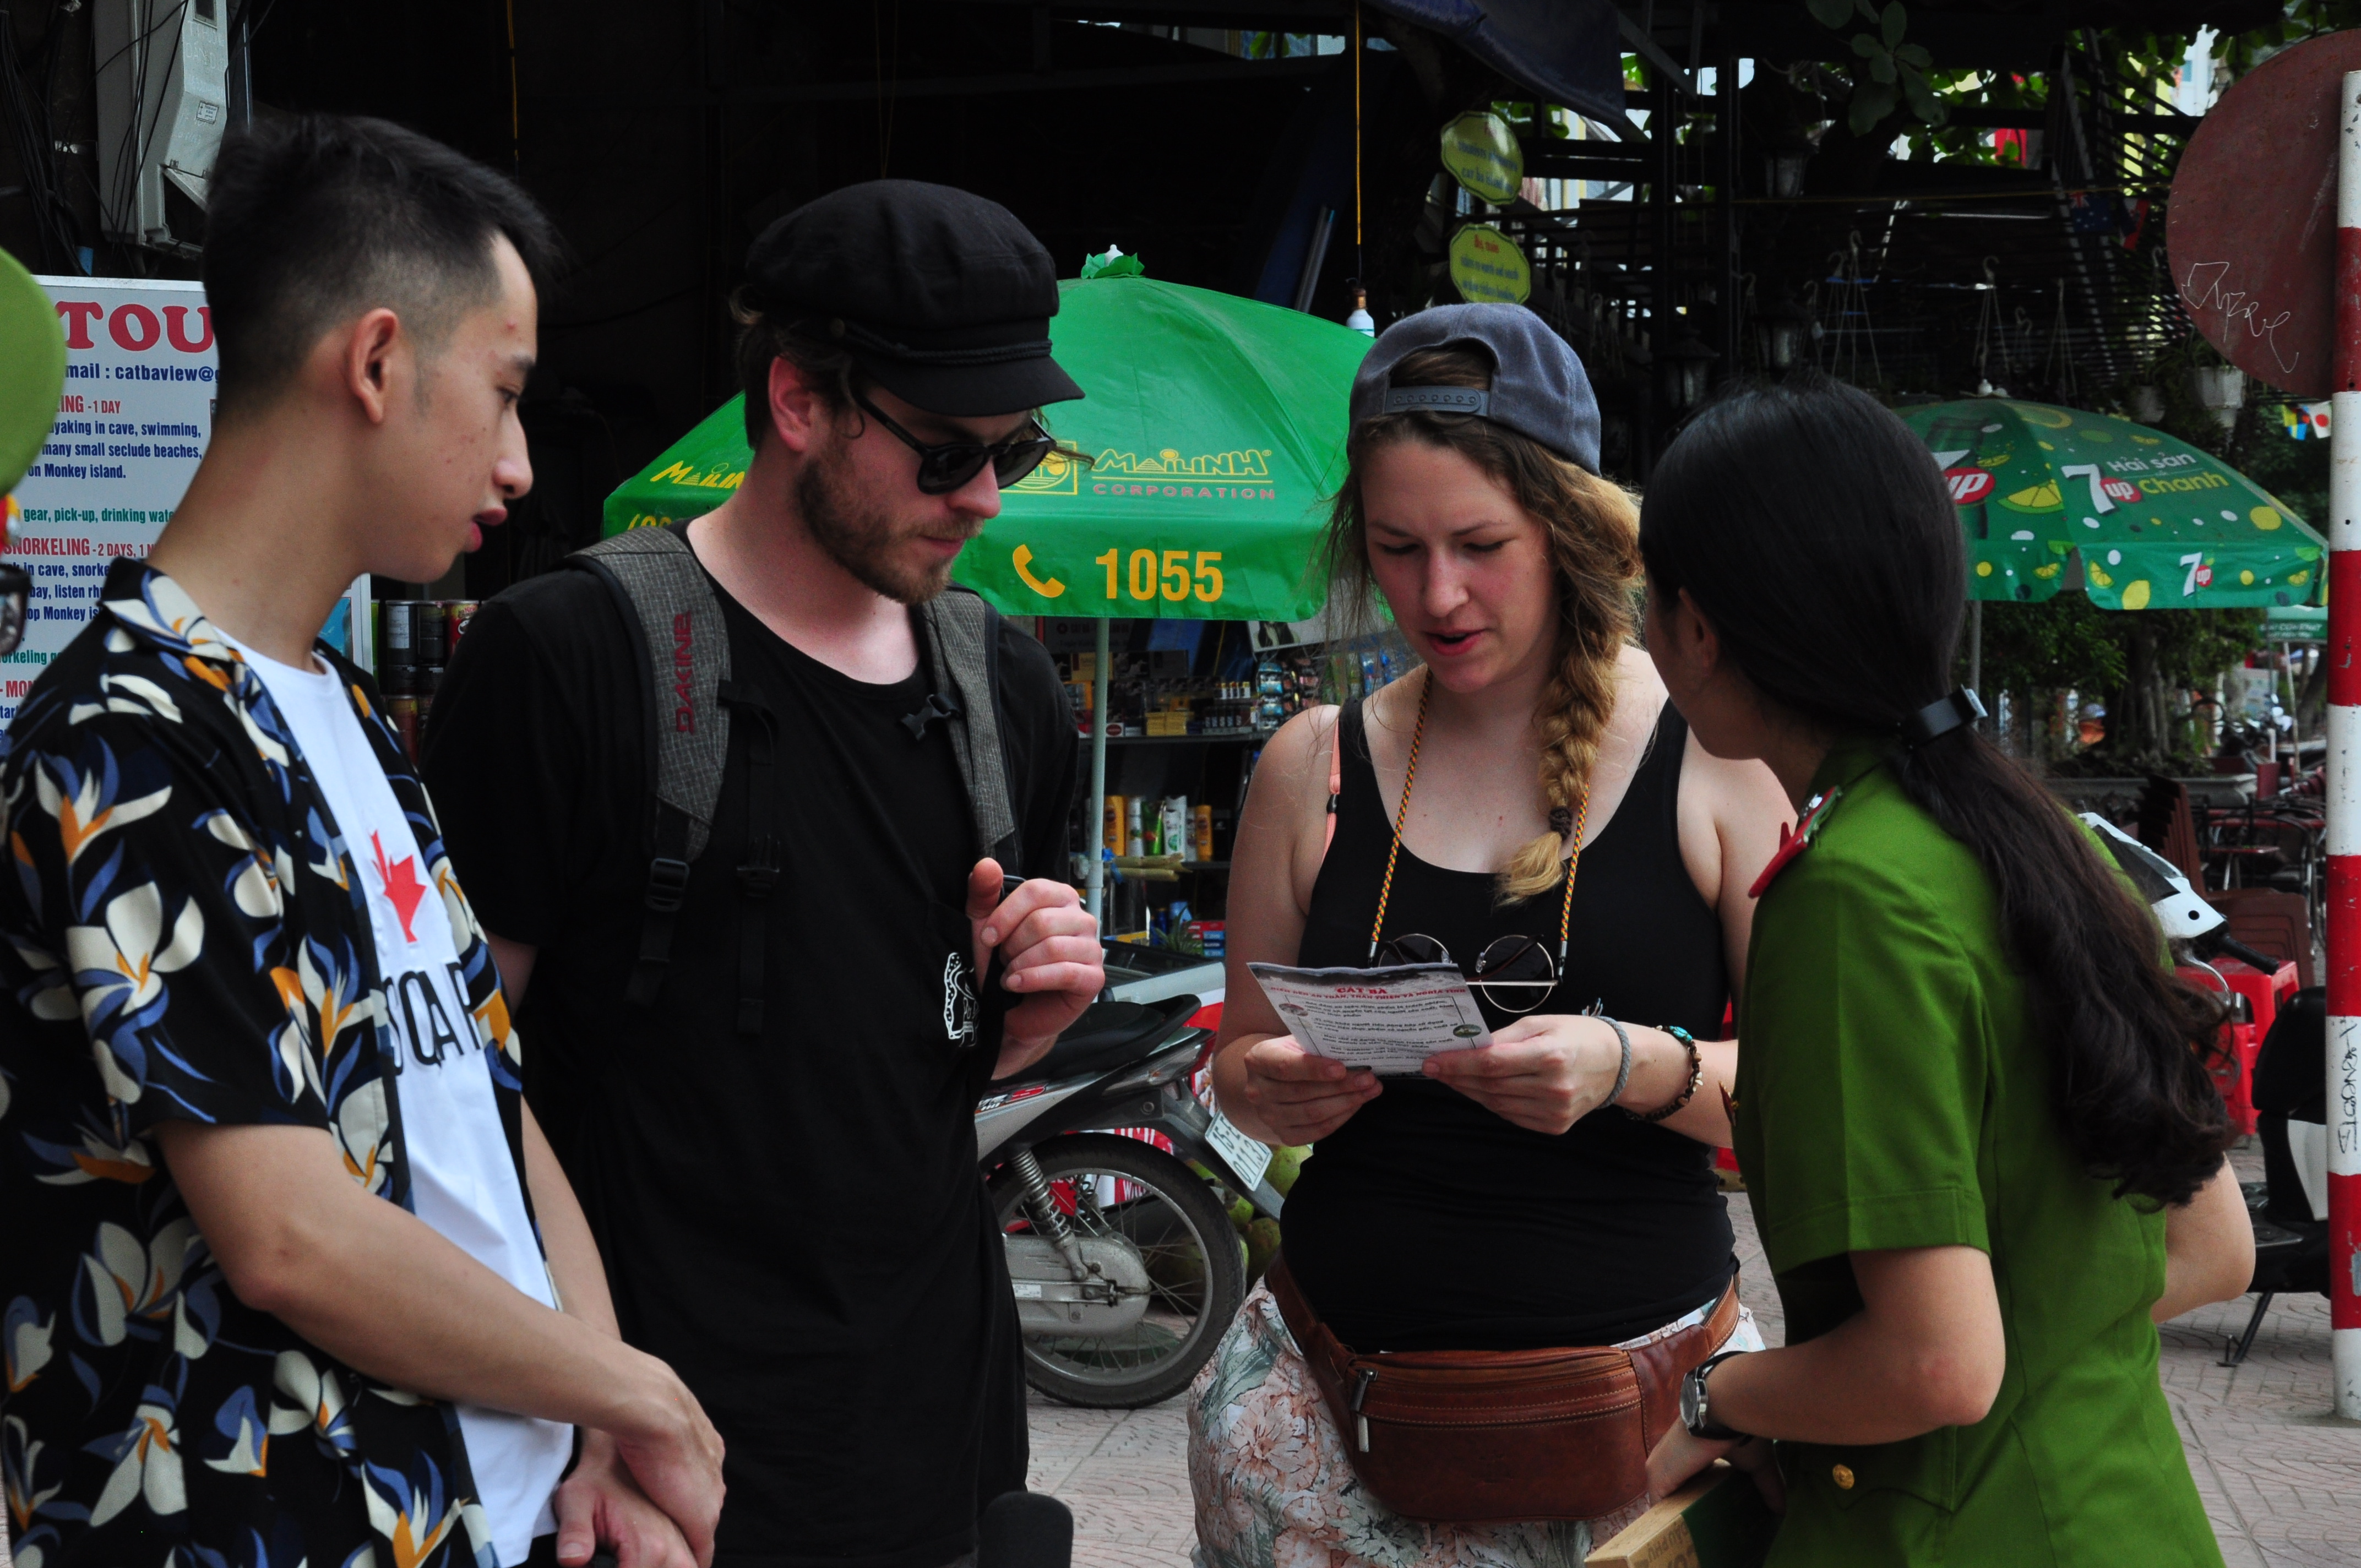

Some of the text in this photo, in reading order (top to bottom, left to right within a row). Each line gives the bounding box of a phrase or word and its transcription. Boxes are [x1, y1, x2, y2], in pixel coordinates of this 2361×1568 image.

[56, 395, 84, 413] ING
[101, 400, 121, 414] DAY
[95, 420, 105, 434] in
[108, 422, 138, 437] cave,
[141, 422, 202, 438] swimming,
[74, 442, 105, 456] small
[108, 443, 151, 458] seclude
[154, 444, 203, 460] beaches,
[44, 463, 86, 480] Monkey
[90, 464, 127, 479] island.
[1093, 483, 1275, 500] CORPORATION
[23, 508, 52, 523] gear,
[54, 508, 99, 524] pick-up,
[101, 508, 146, 524] drinking
[107, 543, 137, 558] DAYS,
[38, 563, 69, 578] cave,
[1095, 548, 1223, 602] 1055
[55, 584, 85, 598] listen
[25, 608, 40, 622] op
[43, 606, 86, 622] Monkey
[674, 612, 695, 735] DAKINE
